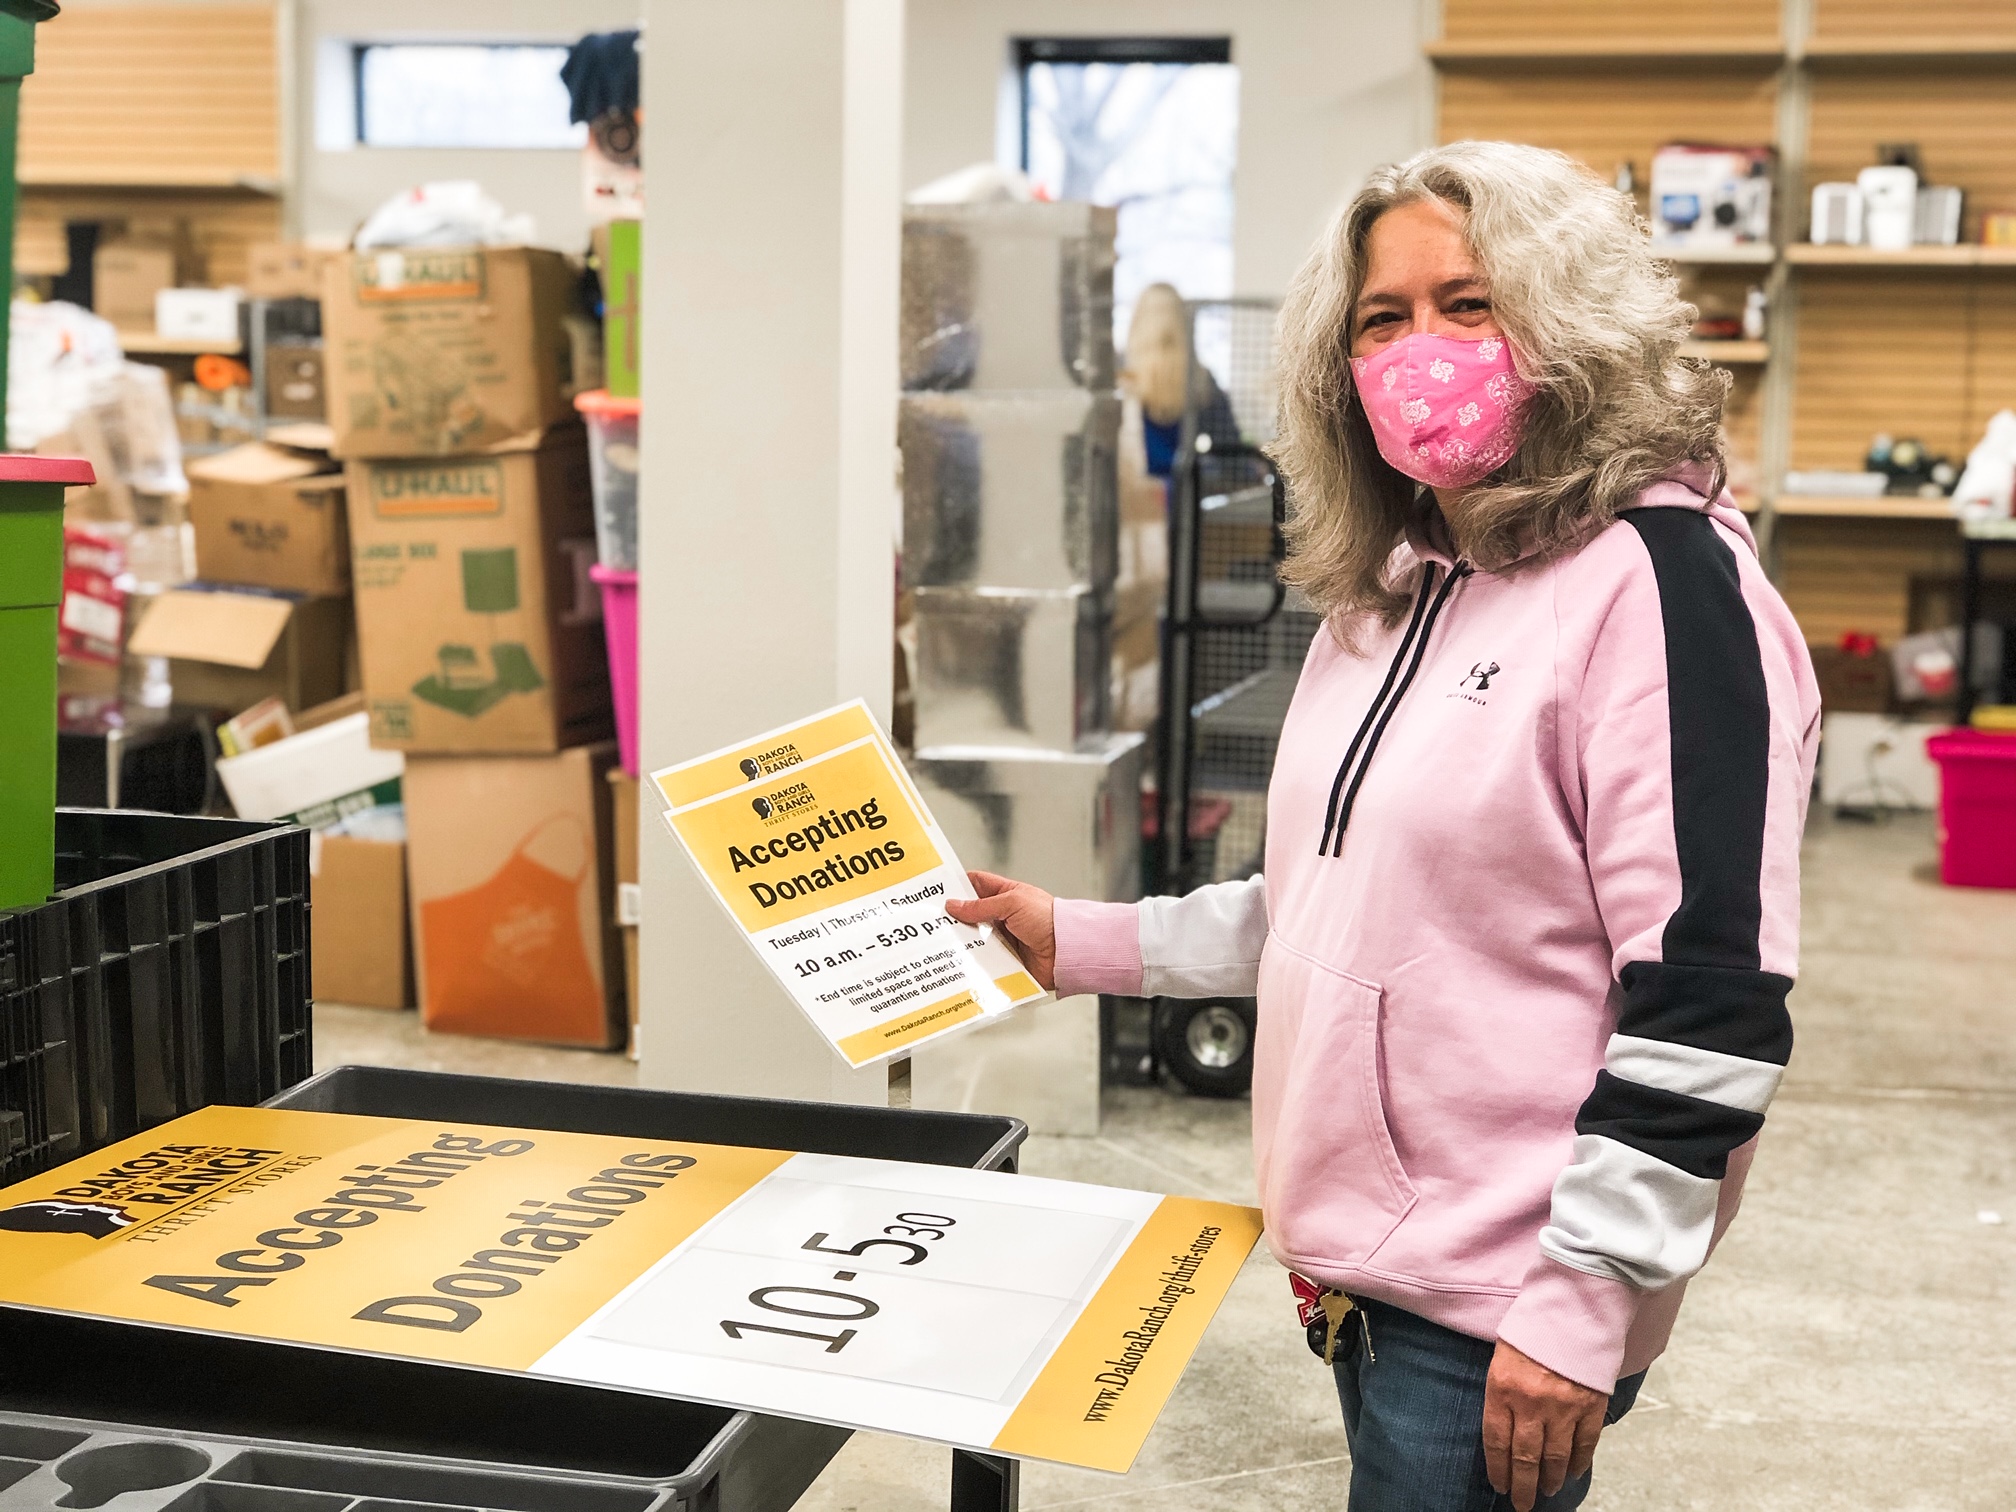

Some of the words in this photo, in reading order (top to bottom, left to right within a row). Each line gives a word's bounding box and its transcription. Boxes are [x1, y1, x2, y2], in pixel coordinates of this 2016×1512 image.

[758, 744, 796, 762] DAKOTA
[765, 754, 803, 774] RANCH
[764, 814, 790, 828] THRIFT
[792, 804, 818, 818] STORES
[770, 782, 808, 801] DAKOTA
[777, 792, 815, 813] RANCH
[728, 798, 887, 873] Accepting
[749, 841, 905, 909] Donations
[768, 926, 821, 950] Tuesday
[890, 882, 945, 908] Saturday
[794, 958, 820, 978] 10
[824, 949, 862, 968] a.m.
[876, 924, 919, 948] 5:30
[840, 983, 863, 996] time
[862, 979, 874, 988] is
[875, 965, 910, 983] subject
[910, 960, 922, 970] to
[973, 939, 985, 947] to
[849, 988, 884, 1006] limited
[884, 978, 913, 993] space
[914, 969, 932, 982] and
[932, 960, 956, 975] need
[870, 989, 920, 1013] quarantine
[921, 971, 966, 993] donations
[53, 1144, 209, 1199] DAKOTA
[99, 1180, 154, 1201] BOYS
[145, 1164, 189, 1182] AND
[181, 1145, 233, 1166] GIRLS
[125, 1148, 284, 1205] RANCH
[127, 1197, 234, 1243] THRIFT
[228, 1154, 323, 1195] STORES
[141, 1133, 536, 1308] Accepting
[350, 1153, 698, 1334] Donations
[1083, 1225, 1222, 1422] www.DakotaRanch.org/thrift-stores
